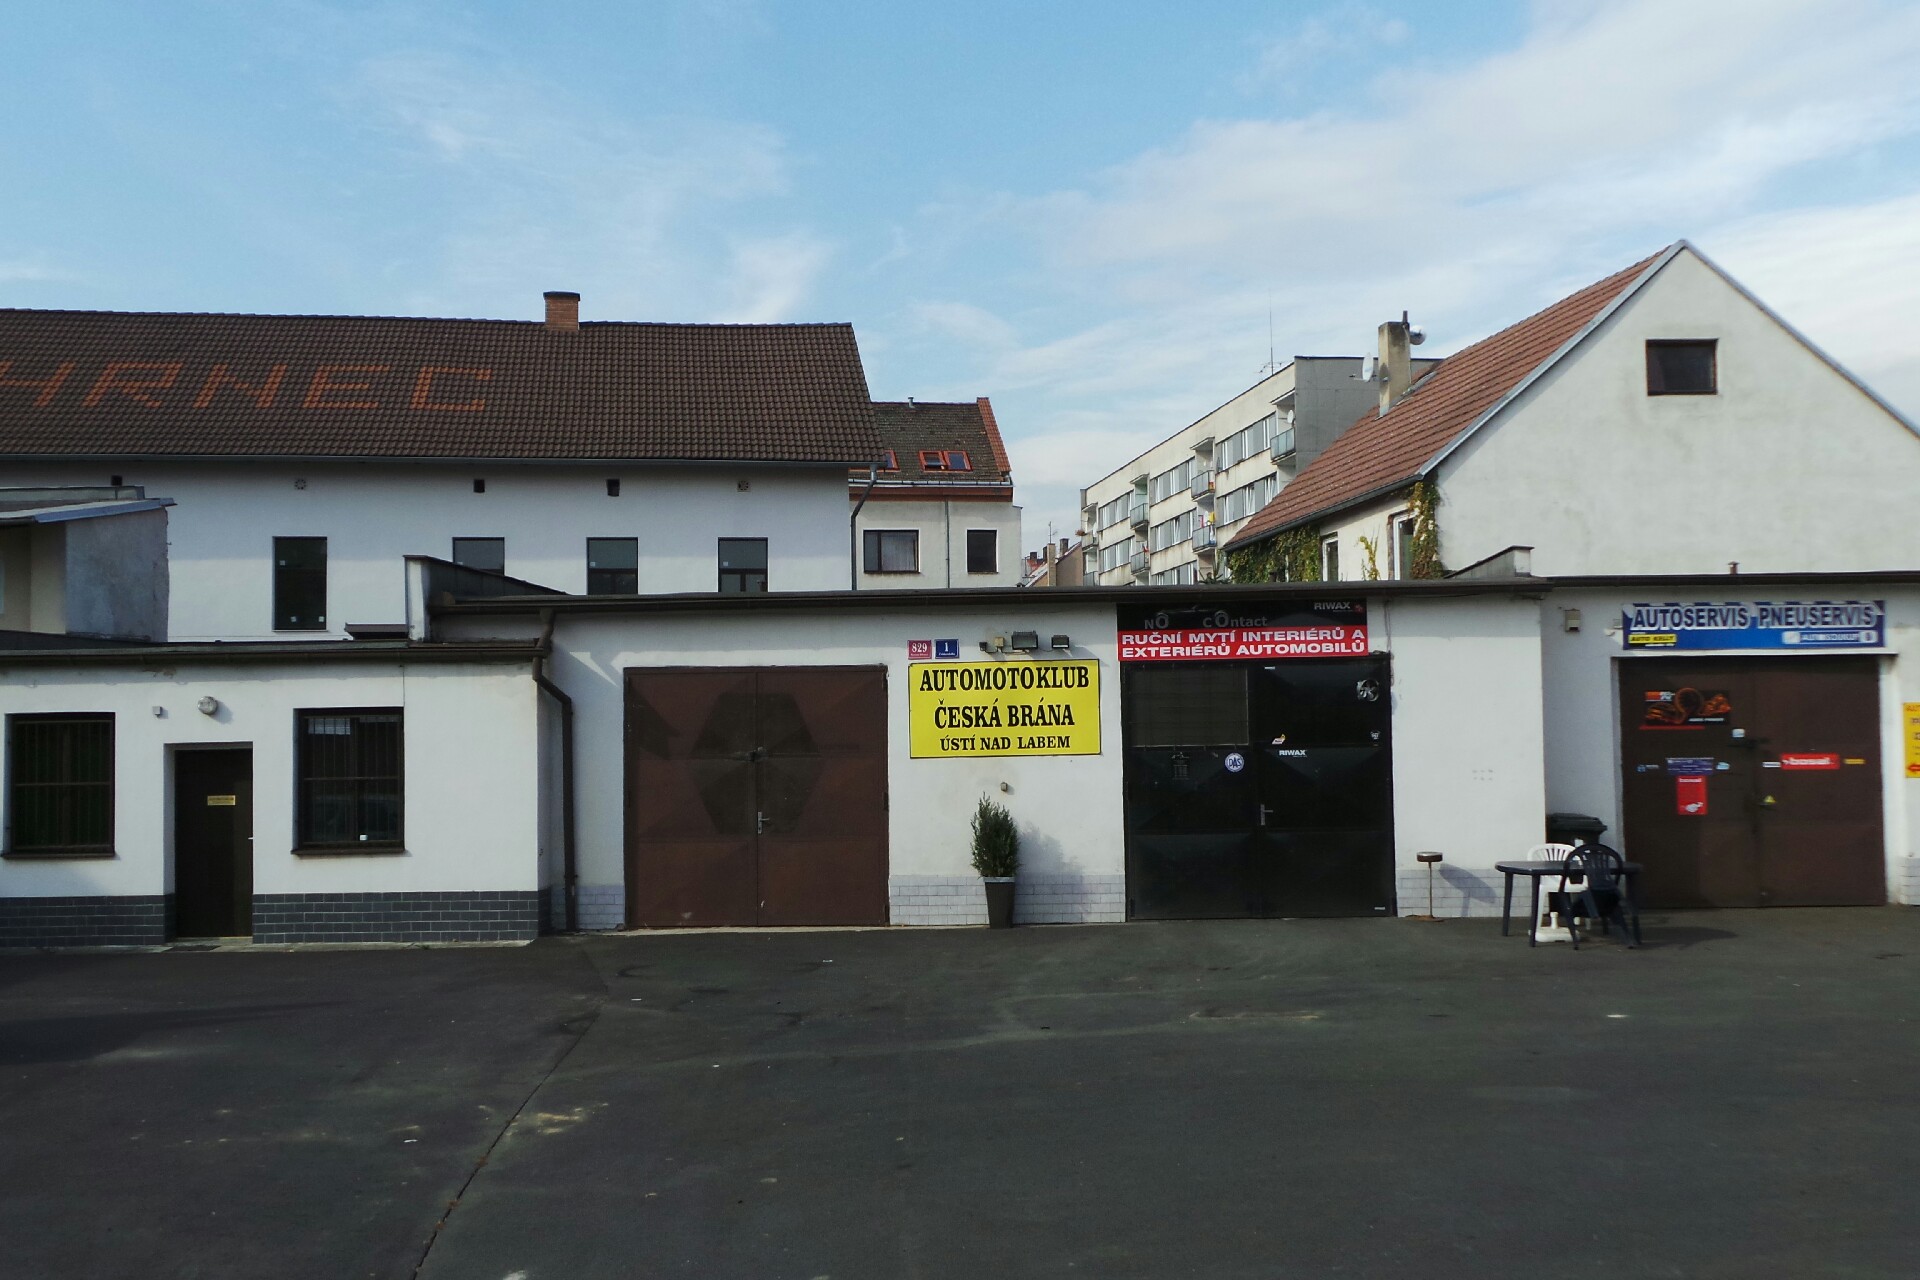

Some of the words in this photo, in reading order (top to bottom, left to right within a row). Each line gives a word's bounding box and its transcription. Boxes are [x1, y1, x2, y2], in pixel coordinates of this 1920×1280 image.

[1313, 601, 1351, 610] RIWAX
[1633, 606, 1749, 629] AUTOSERVIS
[1758, 604, 1876, 627] PNEUSERVIS
[1122, 631, 1182, 645] RUČNÍ
[1188, 629, 1236, 643] MYTÍ
[1242, 627, 1345, 641] INTERIÉRŮ
[1351, 629, 1365, 639] A
[911, 642, 928, 653] 829
[944, 642, 949, 652] 1
[1122, 643, 1231, 658] EXTERIÉRŮ
[1236, 639, 1365, 656] AUTOMOBILŮ
[919, 665, 1089, 692] AUTOMOTOKLUB
[934, 698, 1002, 729] ČESKÁ
[1007, 697, 1075, 728] BRÁNA
[940, 734, 976, 752] ÚSTÍ
[980, 736, 1011, 751] NAD
[1017, 735, 1071, 749] LABEM
[1228, 757, 1242, 768] DAS
